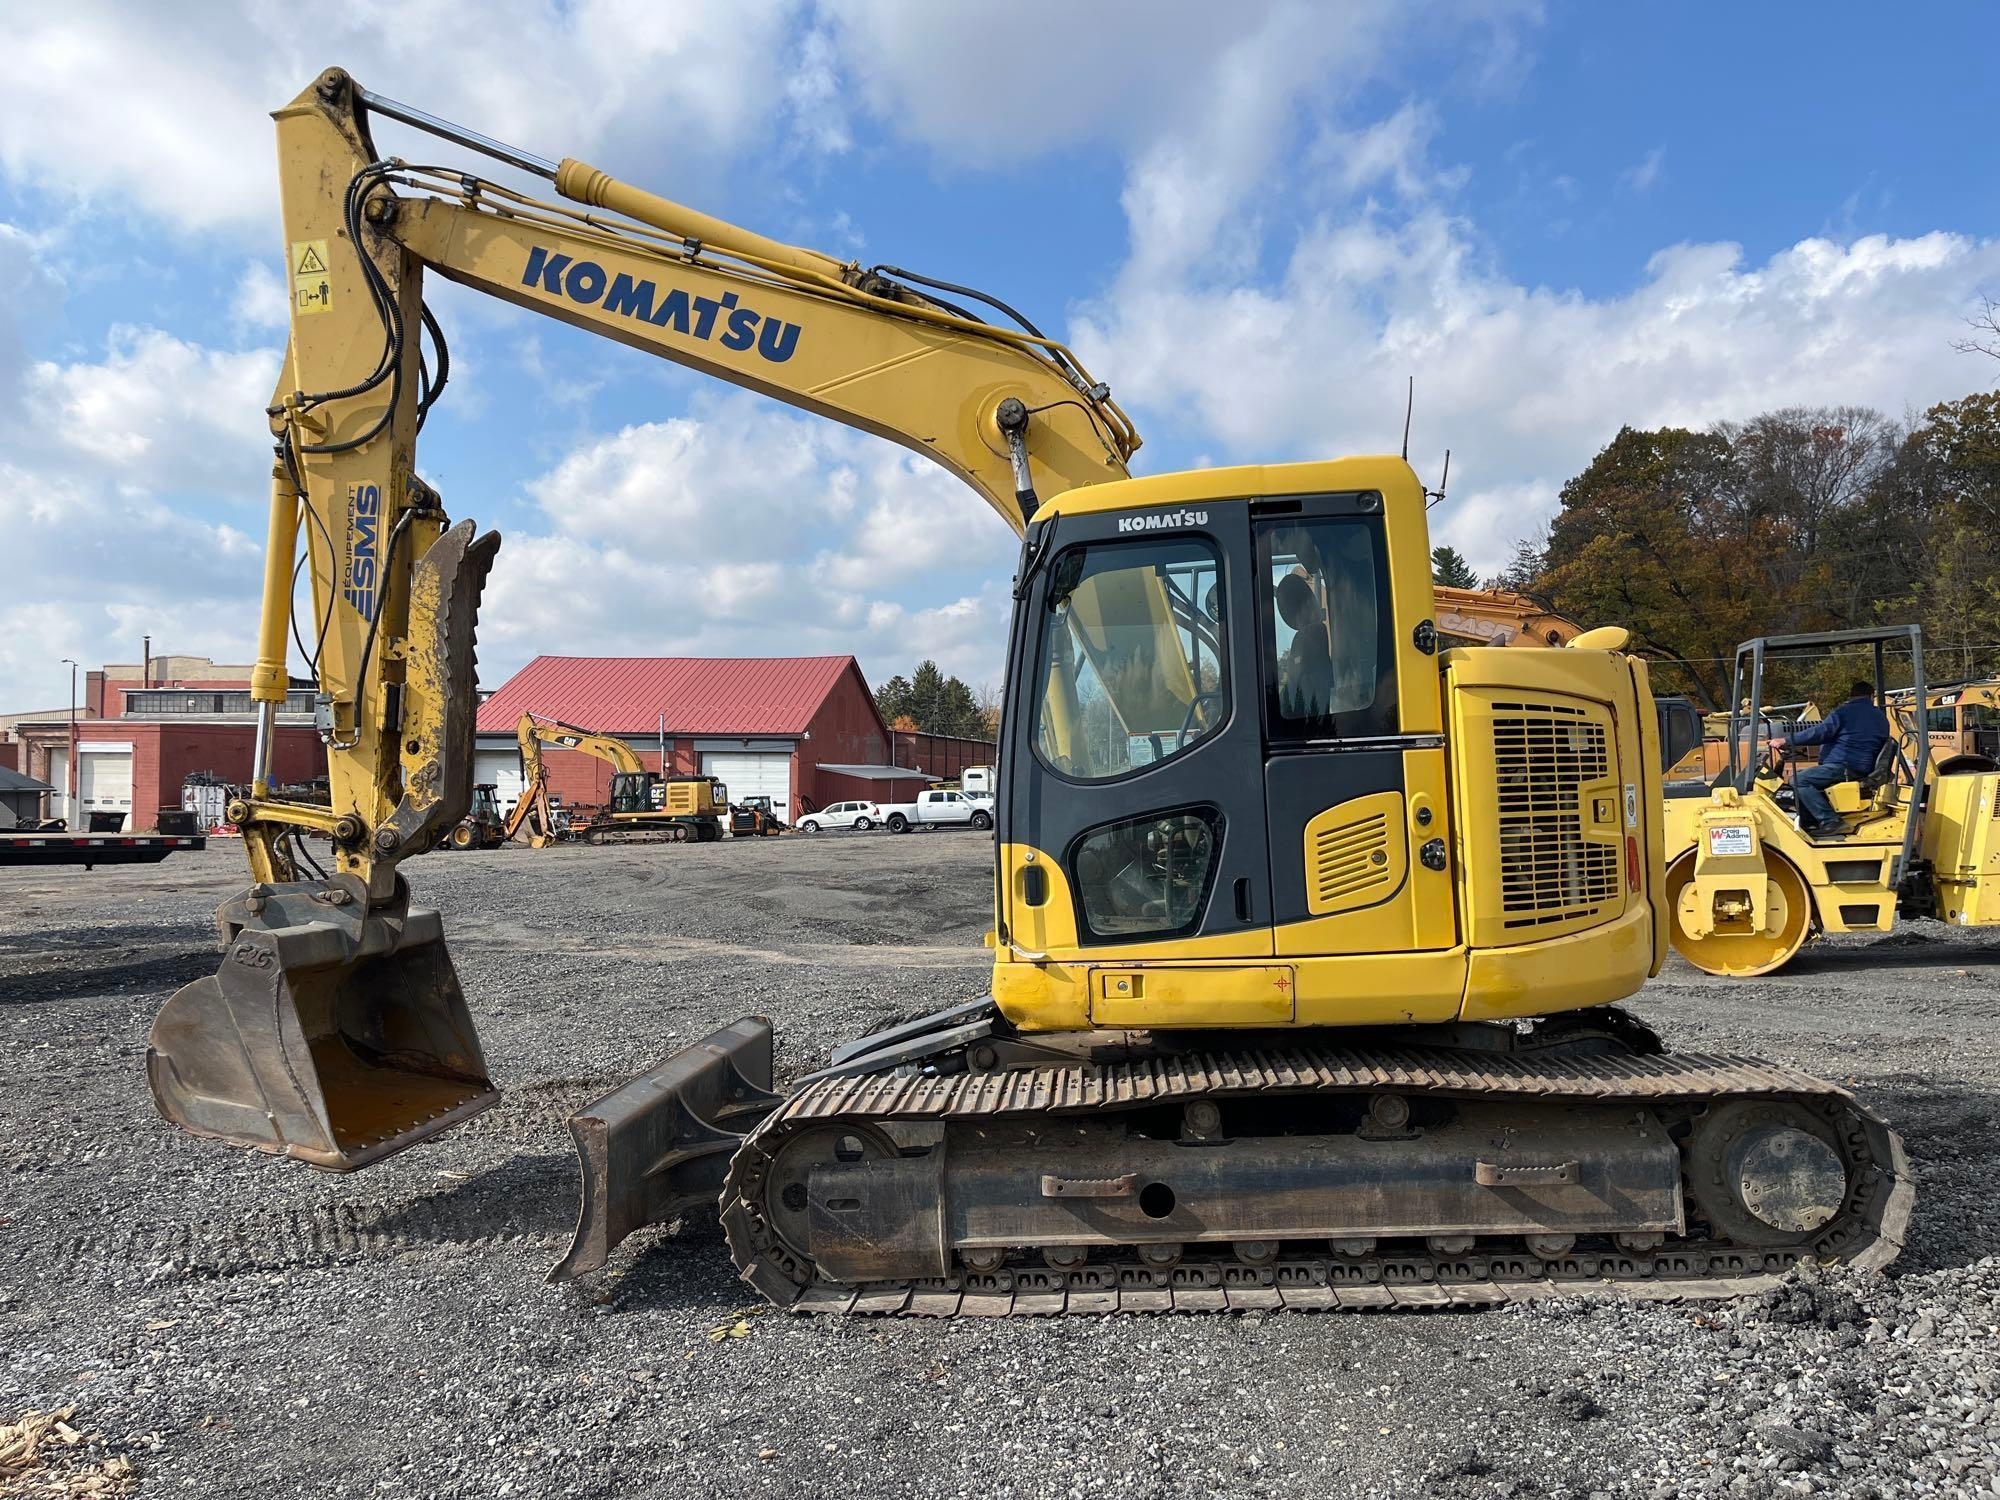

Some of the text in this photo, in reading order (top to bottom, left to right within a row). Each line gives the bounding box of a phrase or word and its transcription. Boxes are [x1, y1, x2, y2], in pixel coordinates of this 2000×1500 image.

[522, 246, 801, 362] KOMATSU
[1119, 509, 1208, 532] KOMATSU
[343, 486, 356, 588] ÉQUIPEMENT
[353, 485, 378, 589] SMS
[1440, 613, 1515, 644] CASE
[1942, 695, 1956, 705] CAT
[563, 736, 576, 746] CAT
[713, 786, 726, 804] CAT
